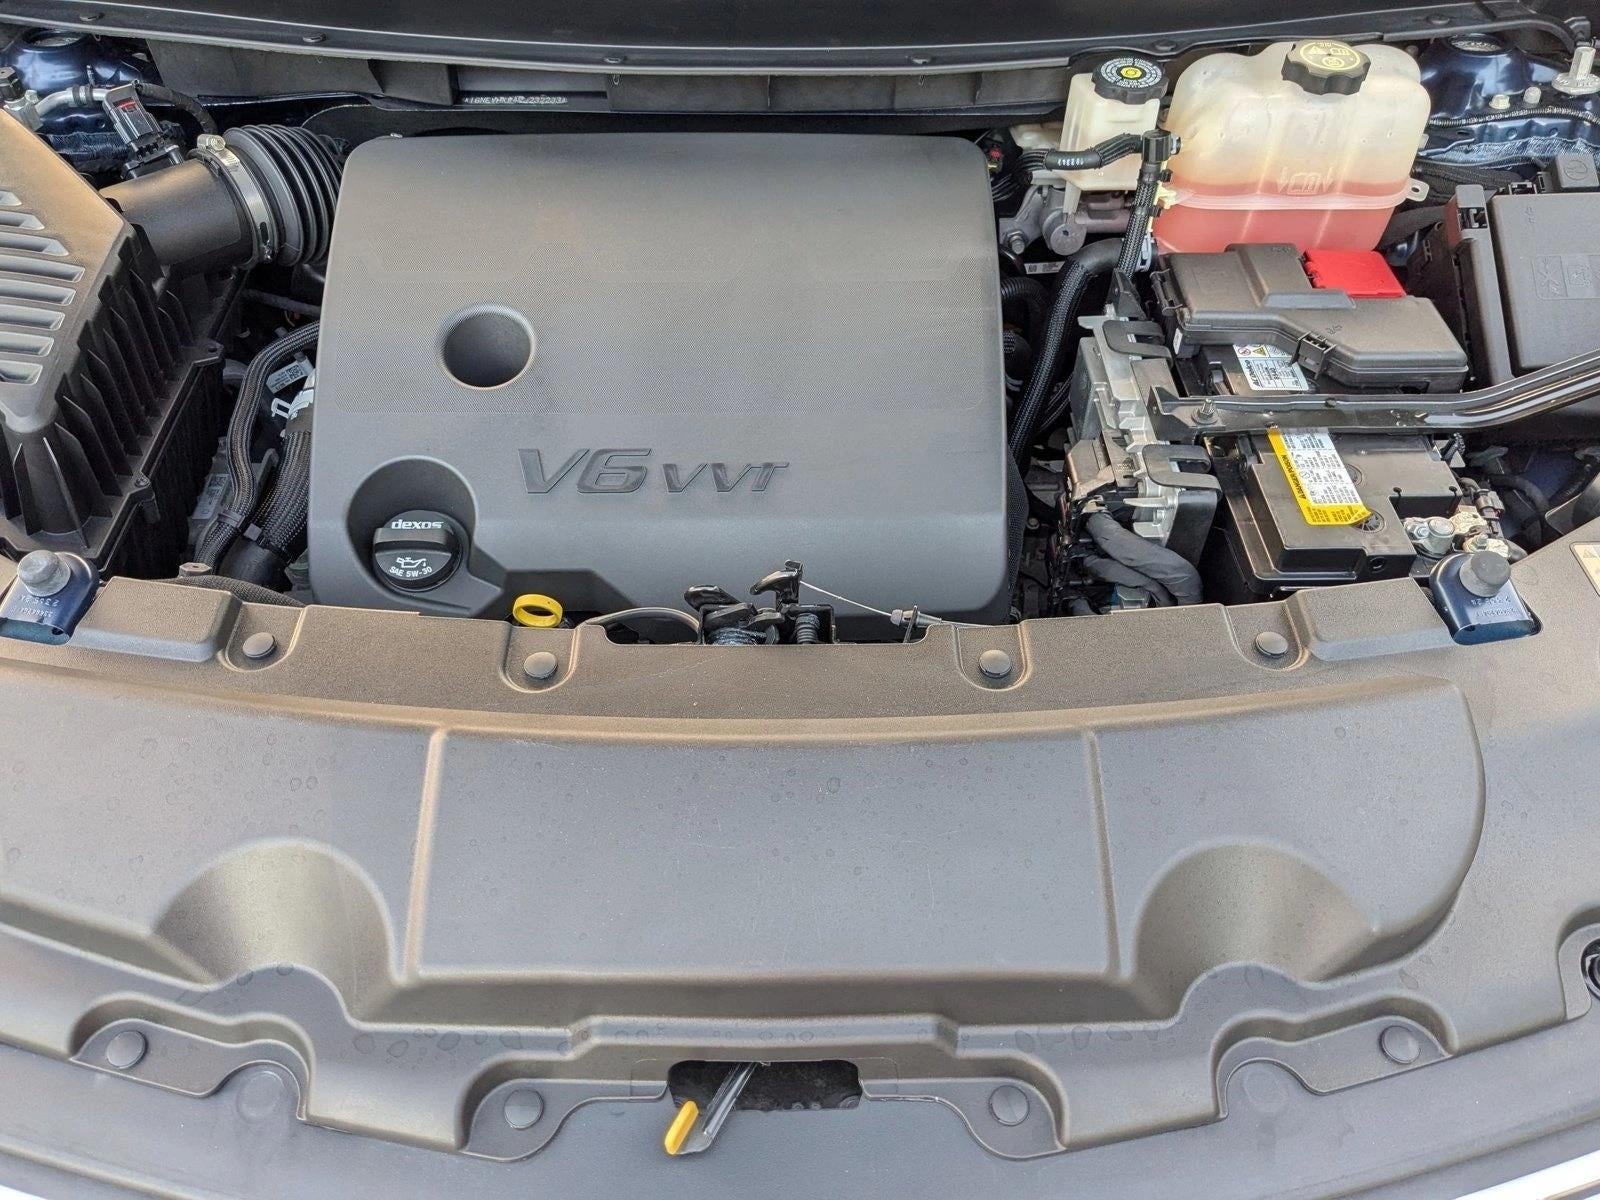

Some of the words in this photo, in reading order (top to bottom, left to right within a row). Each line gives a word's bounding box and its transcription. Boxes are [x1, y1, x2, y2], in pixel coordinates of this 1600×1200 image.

[518, 449, 651, 493] V6
[663, 462, 789, 492] VVT
[391, 519, 444, 530] dexos
[389, 566, 405, 577] SAE
[406, 566, 433, 578] 5W-30
